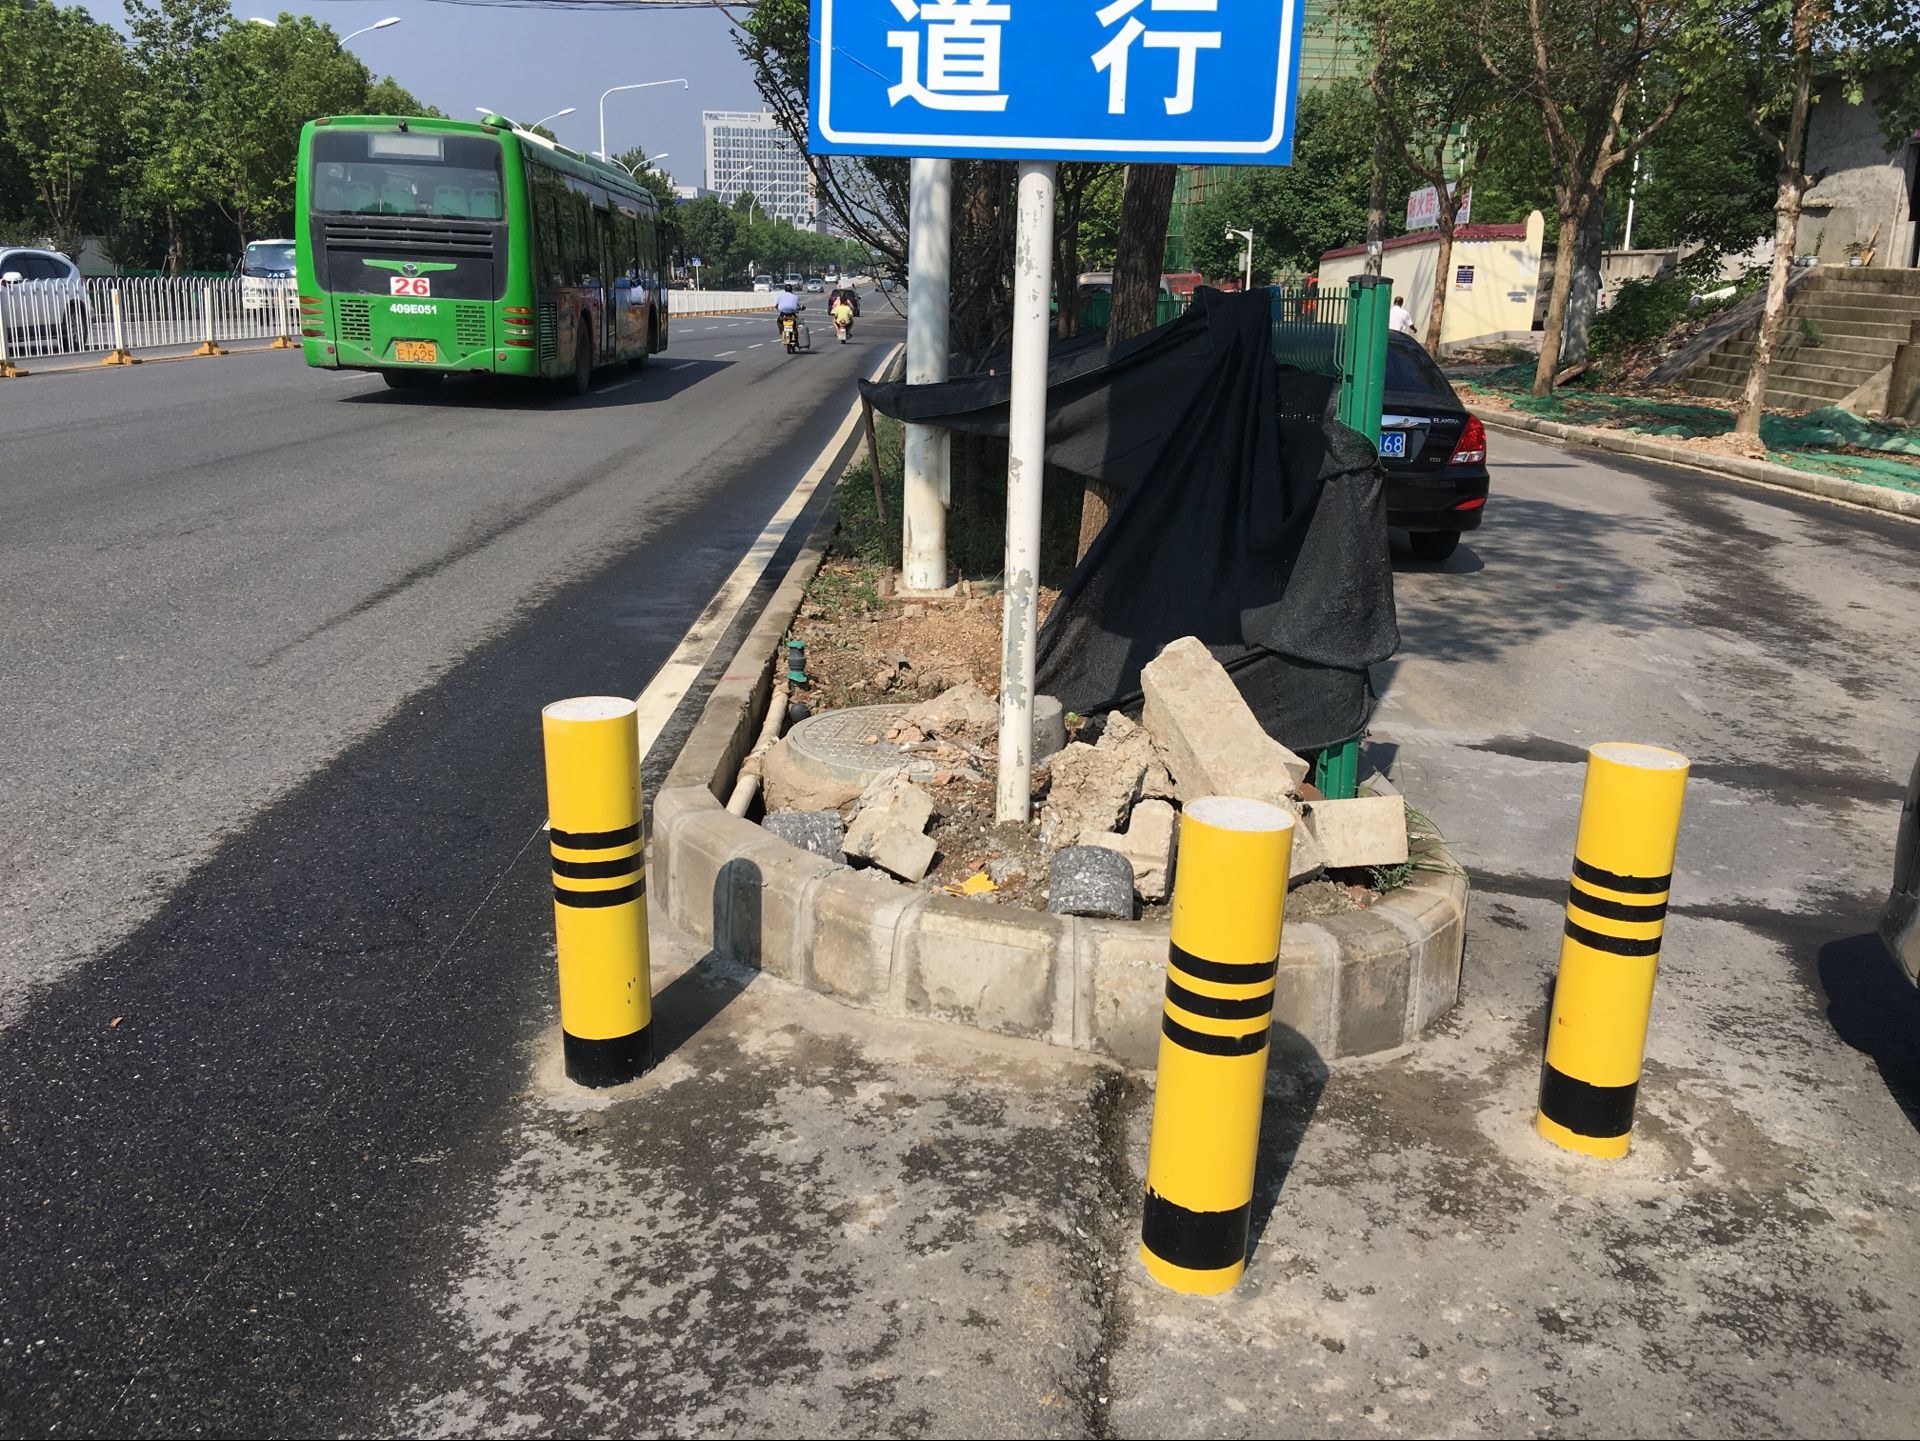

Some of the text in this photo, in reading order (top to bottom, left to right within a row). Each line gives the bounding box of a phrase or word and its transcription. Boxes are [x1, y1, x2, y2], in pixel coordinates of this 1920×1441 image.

[395, 278, 428, 295] 26
[389, 303, 437, 315] 409E051
[397, 349, 435, 362] E1625
[1380, 436, 1403, 452] 68
